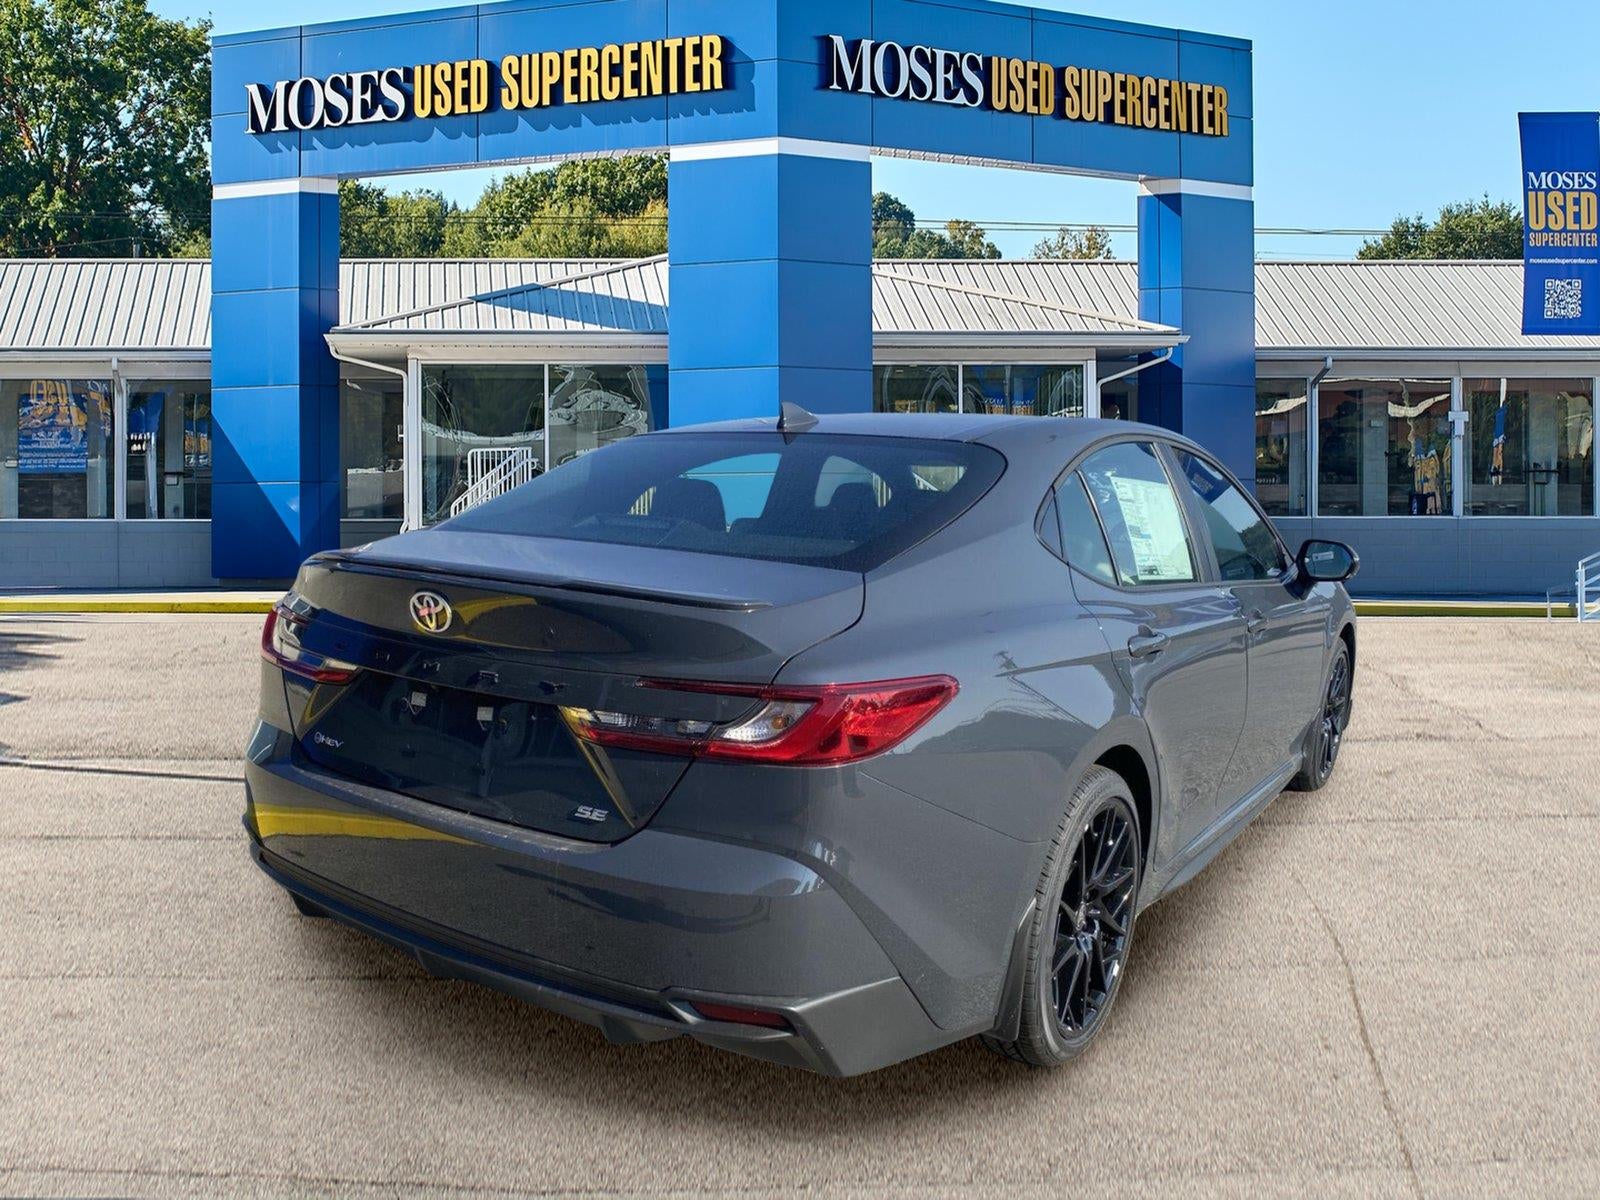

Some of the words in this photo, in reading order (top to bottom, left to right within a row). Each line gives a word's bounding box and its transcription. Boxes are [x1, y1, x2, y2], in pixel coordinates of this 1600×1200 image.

[244, 66, 409, 134] MOSES
[412, 59, 489, 118] USED
[500, 34, 724, 110] SUPERCENTER
[829, 34, 985, 107] MOSES
[990, 56, 1055, 116] USED
[1064, 66, 1229, 136] SUPERCENTER
[1528, 171, 1597, 190] MOSES
[1528, 191, 1597, 231] USED
[1529, 232, 1598, 247] SUPERCENTER
[574, 805, 609, 822] SE
